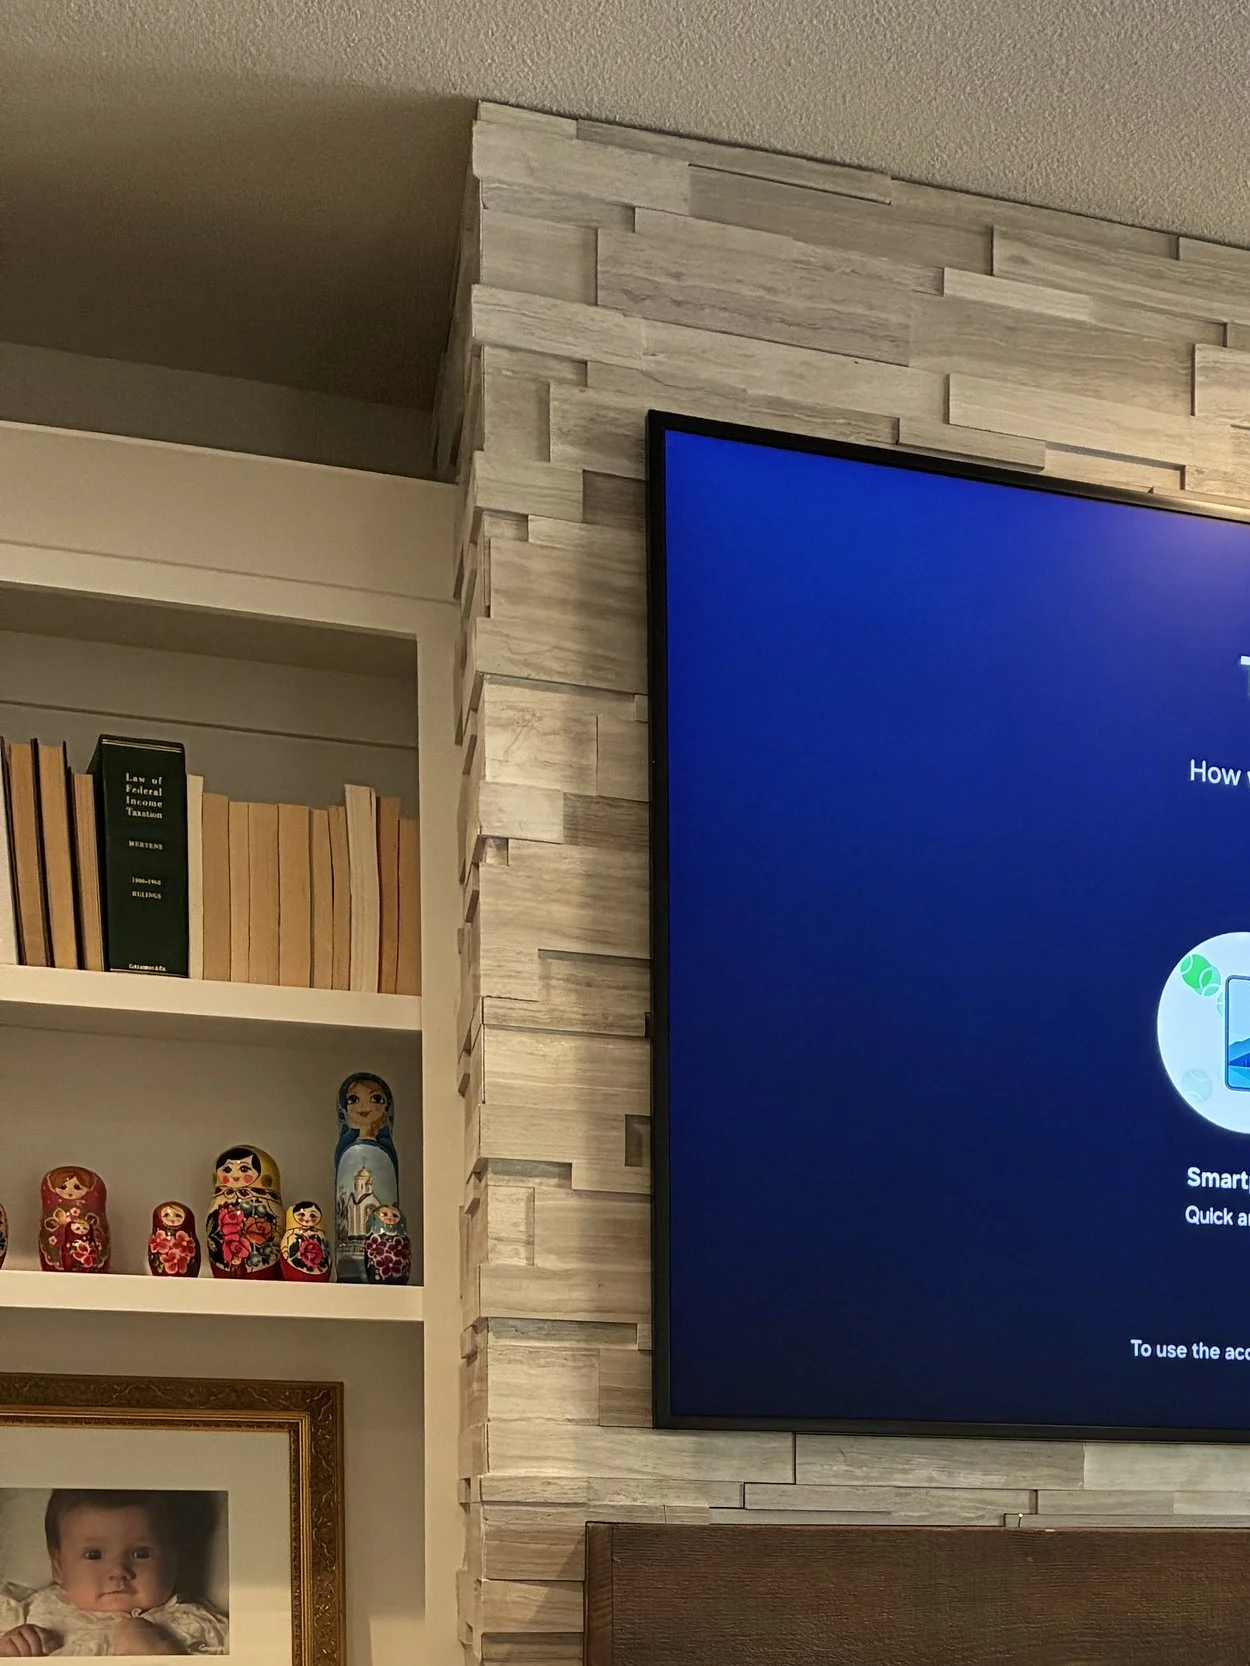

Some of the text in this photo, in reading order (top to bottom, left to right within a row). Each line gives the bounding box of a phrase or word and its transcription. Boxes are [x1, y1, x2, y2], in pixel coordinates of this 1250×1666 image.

[125, 772, 163, 785] Law of
[1190, 758, 1242, 787] How
[125, 783, 163, 797] Federal
[125, 795, 163, 808] Income
[125, 806, 163, 819] Taxation
[1184, 1204, 1234, 1226] Quick
[1130, 1338, 1152, 1358] To
[1156, 1344, 1188, 1359] use
[1191, 1341, 1221, 1360] the
